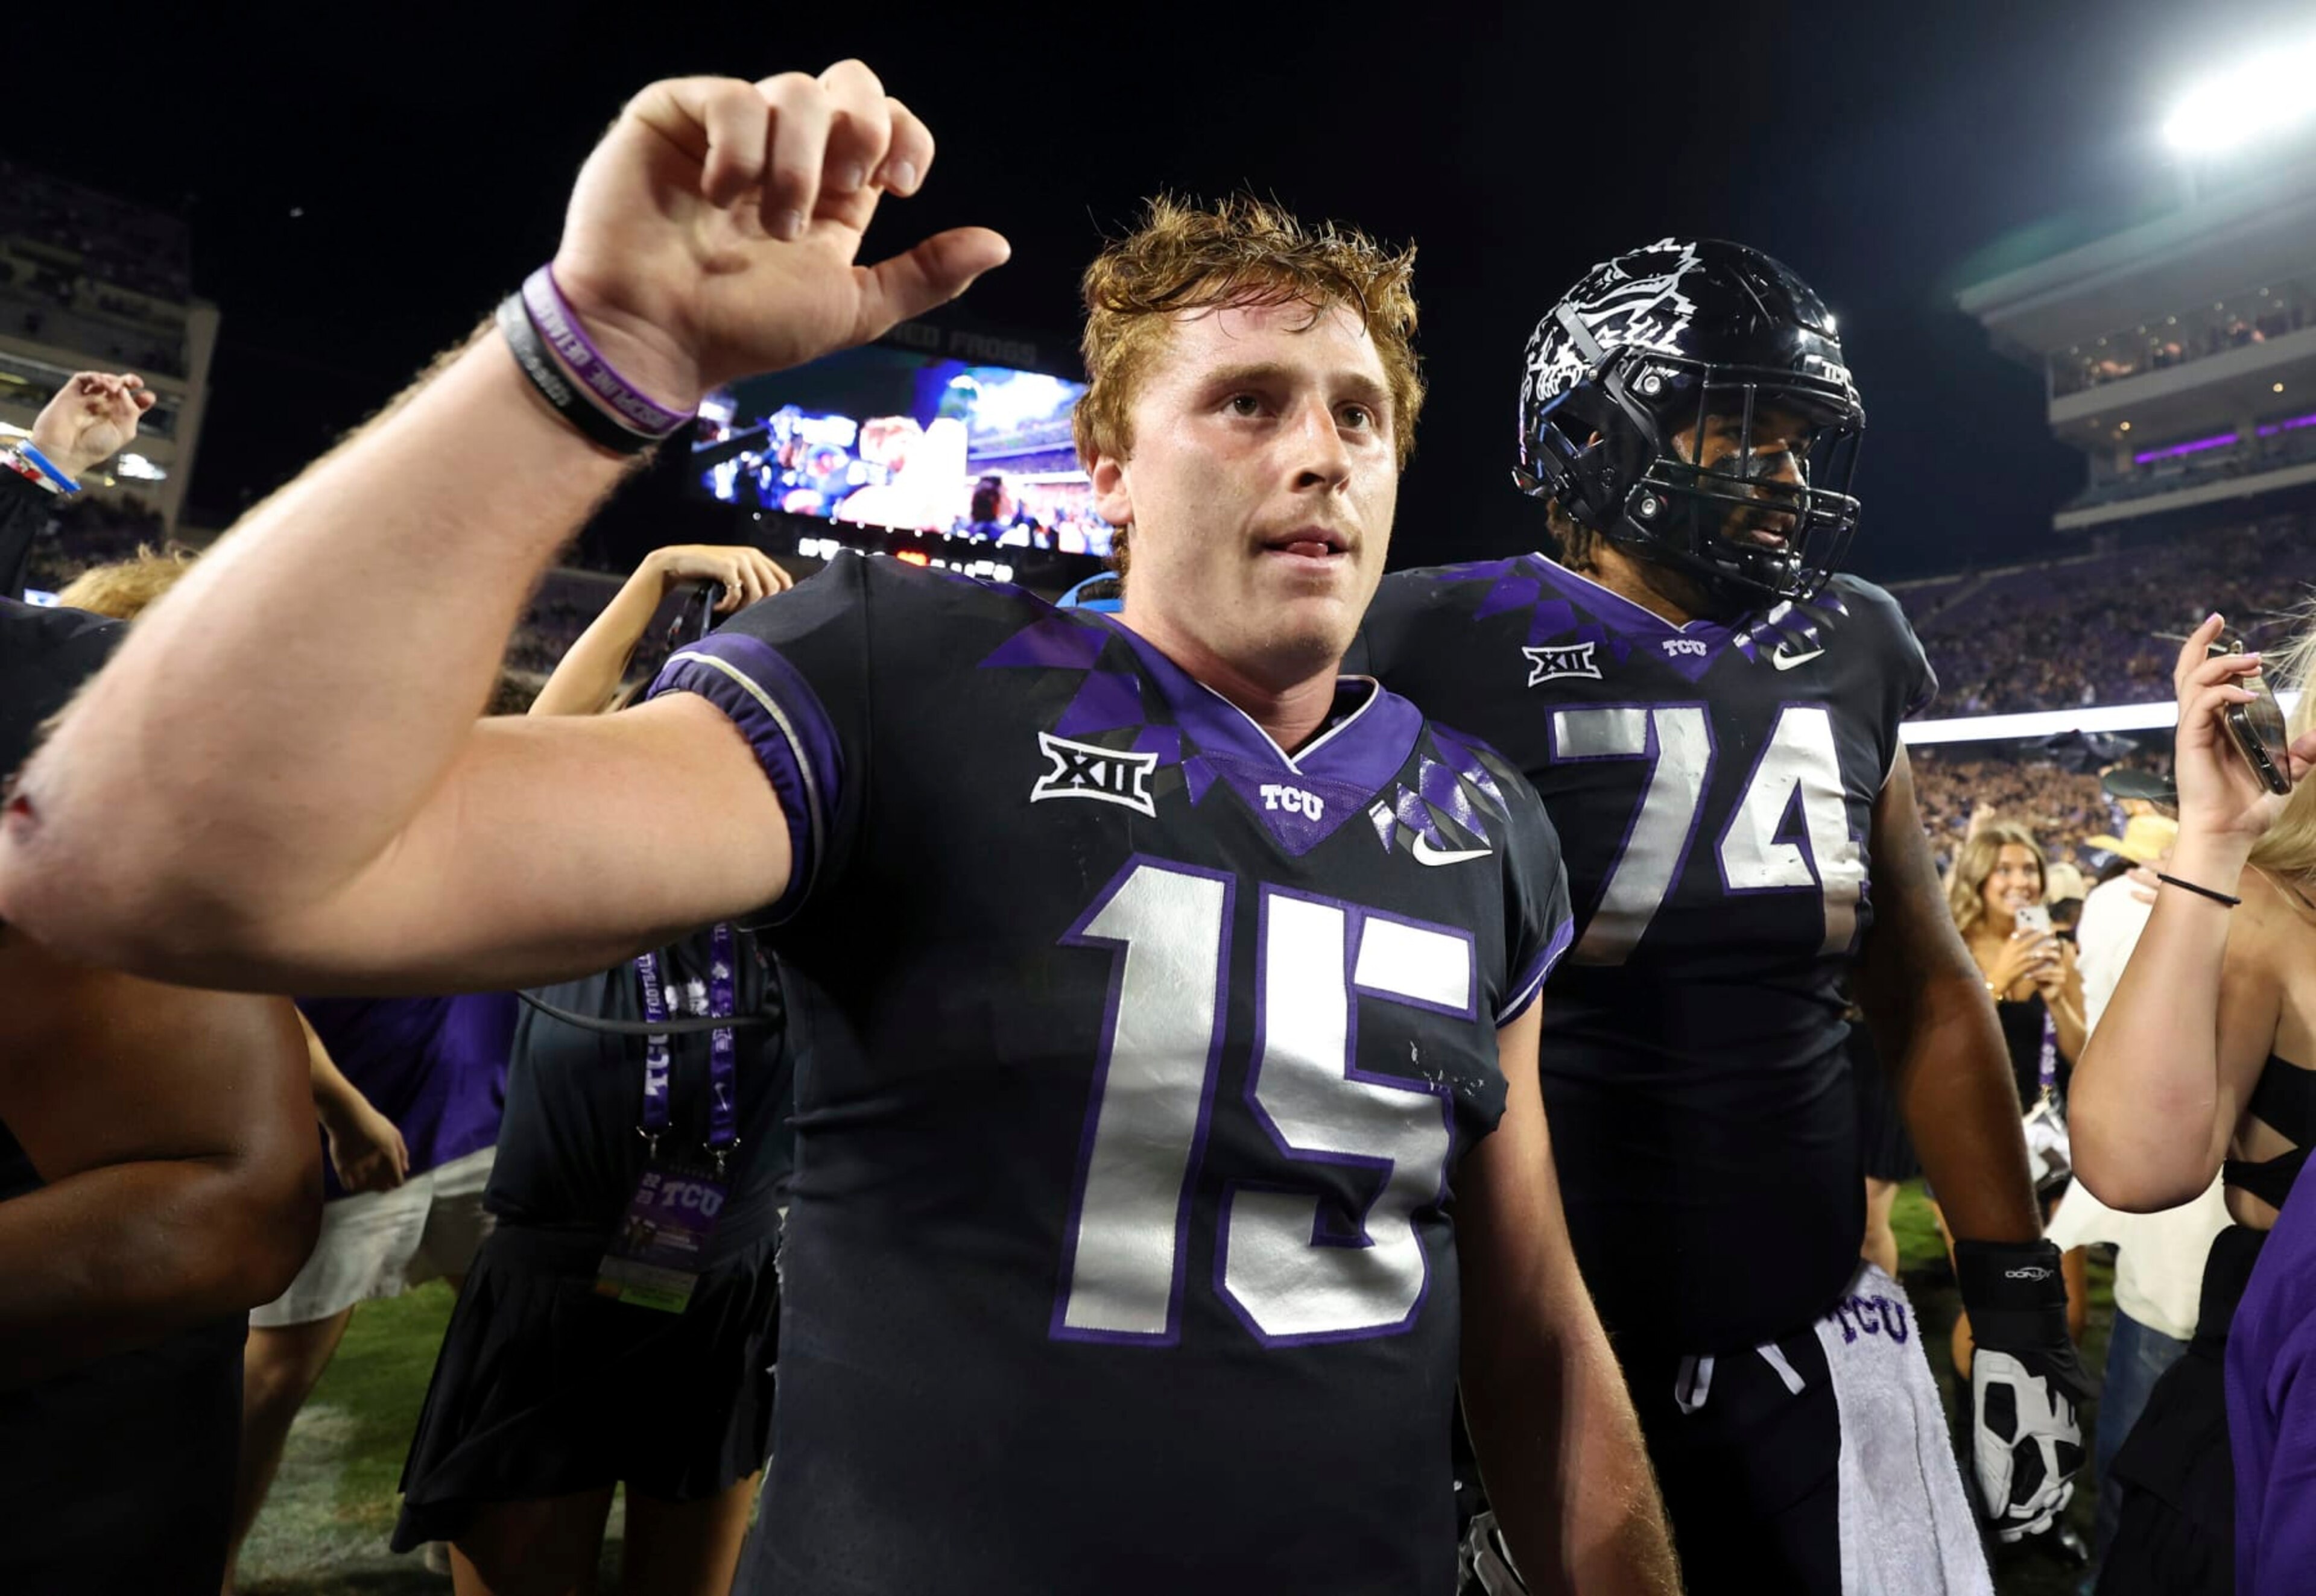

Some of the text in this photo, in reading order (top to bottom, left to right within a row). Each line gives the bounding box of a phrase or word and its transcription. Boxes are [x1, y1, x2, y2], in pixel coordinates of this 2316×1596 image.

[1662, 639, 1707, 657] TCU
[1260, 784, 1324, 822] TCU
[1545, 700, 1870, 965] 74
[1049, 851, 1477, 1348] 15
[662, 1180, 724, 1219] TCU
[1829, 1295, 1908, 1345] TCU
